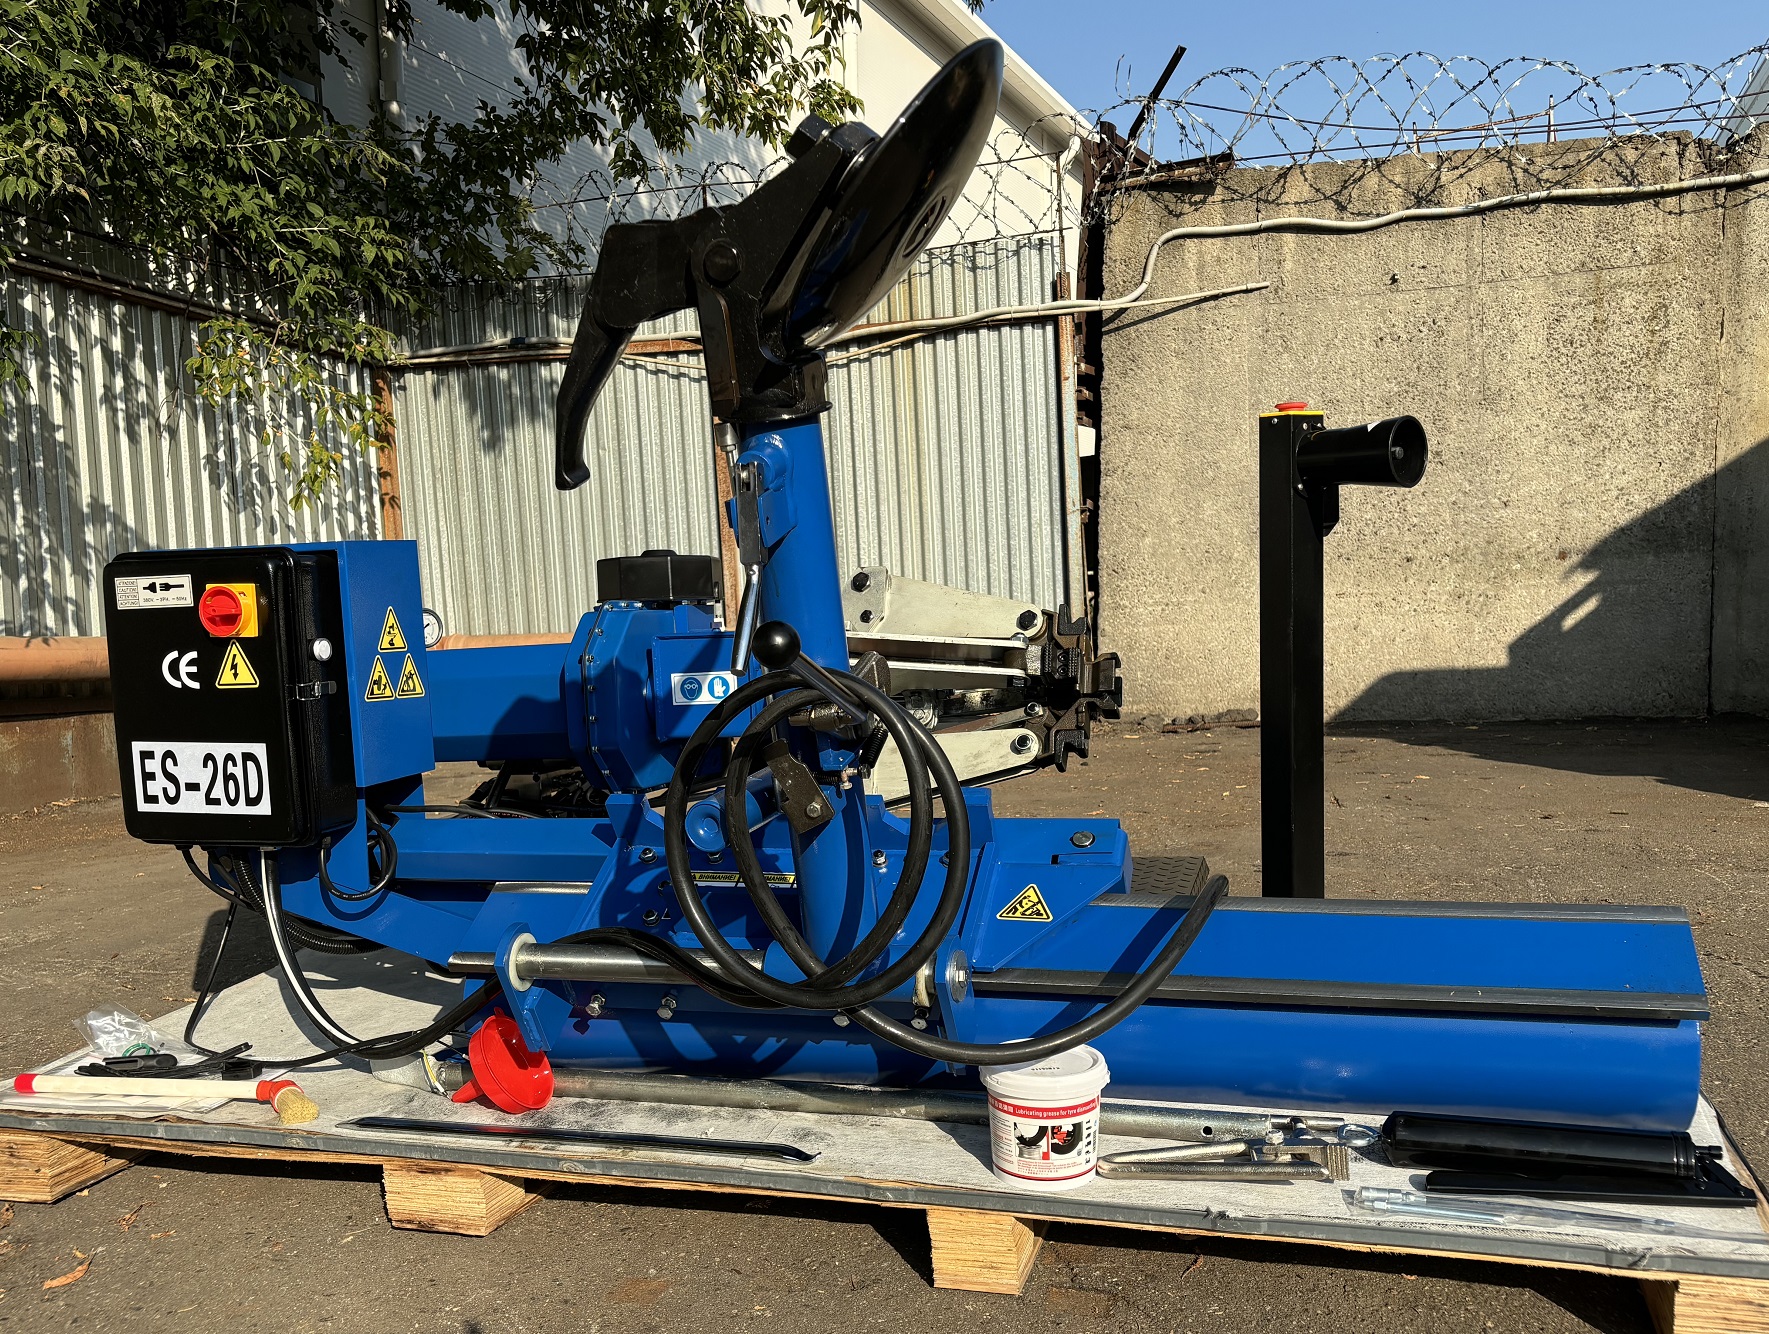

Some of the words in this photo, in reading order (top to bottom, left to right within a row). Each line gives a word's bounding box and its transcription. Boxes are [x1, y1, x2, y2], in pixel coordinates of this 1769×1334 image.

[161, 650, 200, 689] CE
[139, 749, 264, 807] ES-26D
[1015, 1107, 1042, 1118] Lubricating
